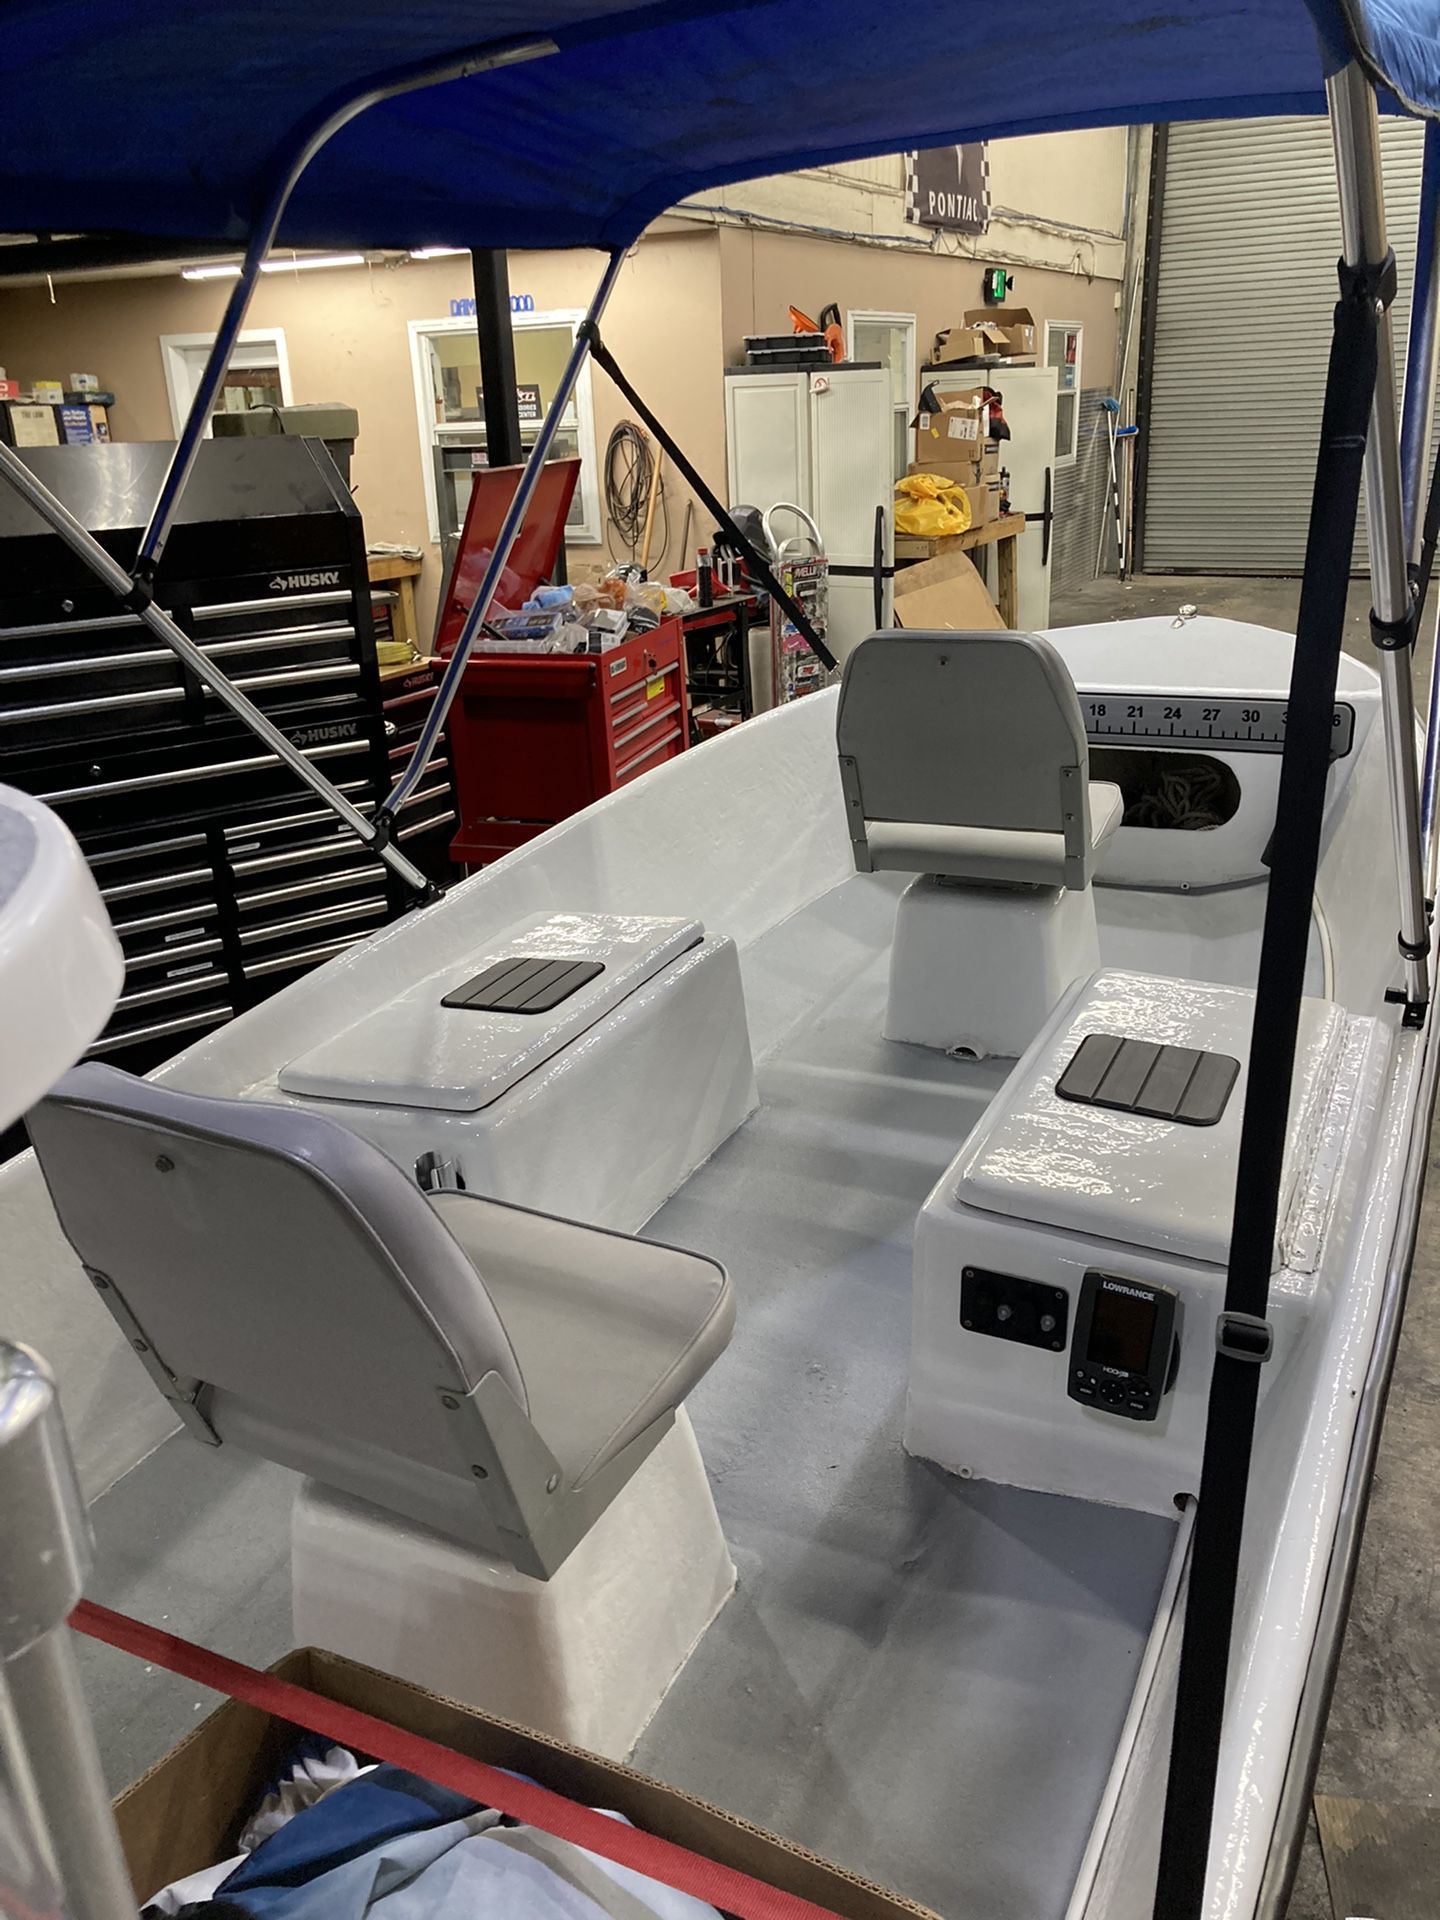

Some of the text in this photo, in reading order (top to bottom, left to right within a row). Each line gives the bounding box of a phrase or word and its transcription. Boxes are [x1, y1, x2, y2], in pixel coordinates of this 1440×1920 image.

[928, 190, 978, 222] PONTIAC
[288, 571, 340, 589] HUSKY
[410, 672, 434, 687] HUSKY
[1089, 704, 1341, 727] 18 21 24 27 30 3 6
[307, 723, 357, 742] HUSKY
[1102, 1280, 1155, 1301] LOWRANCE
